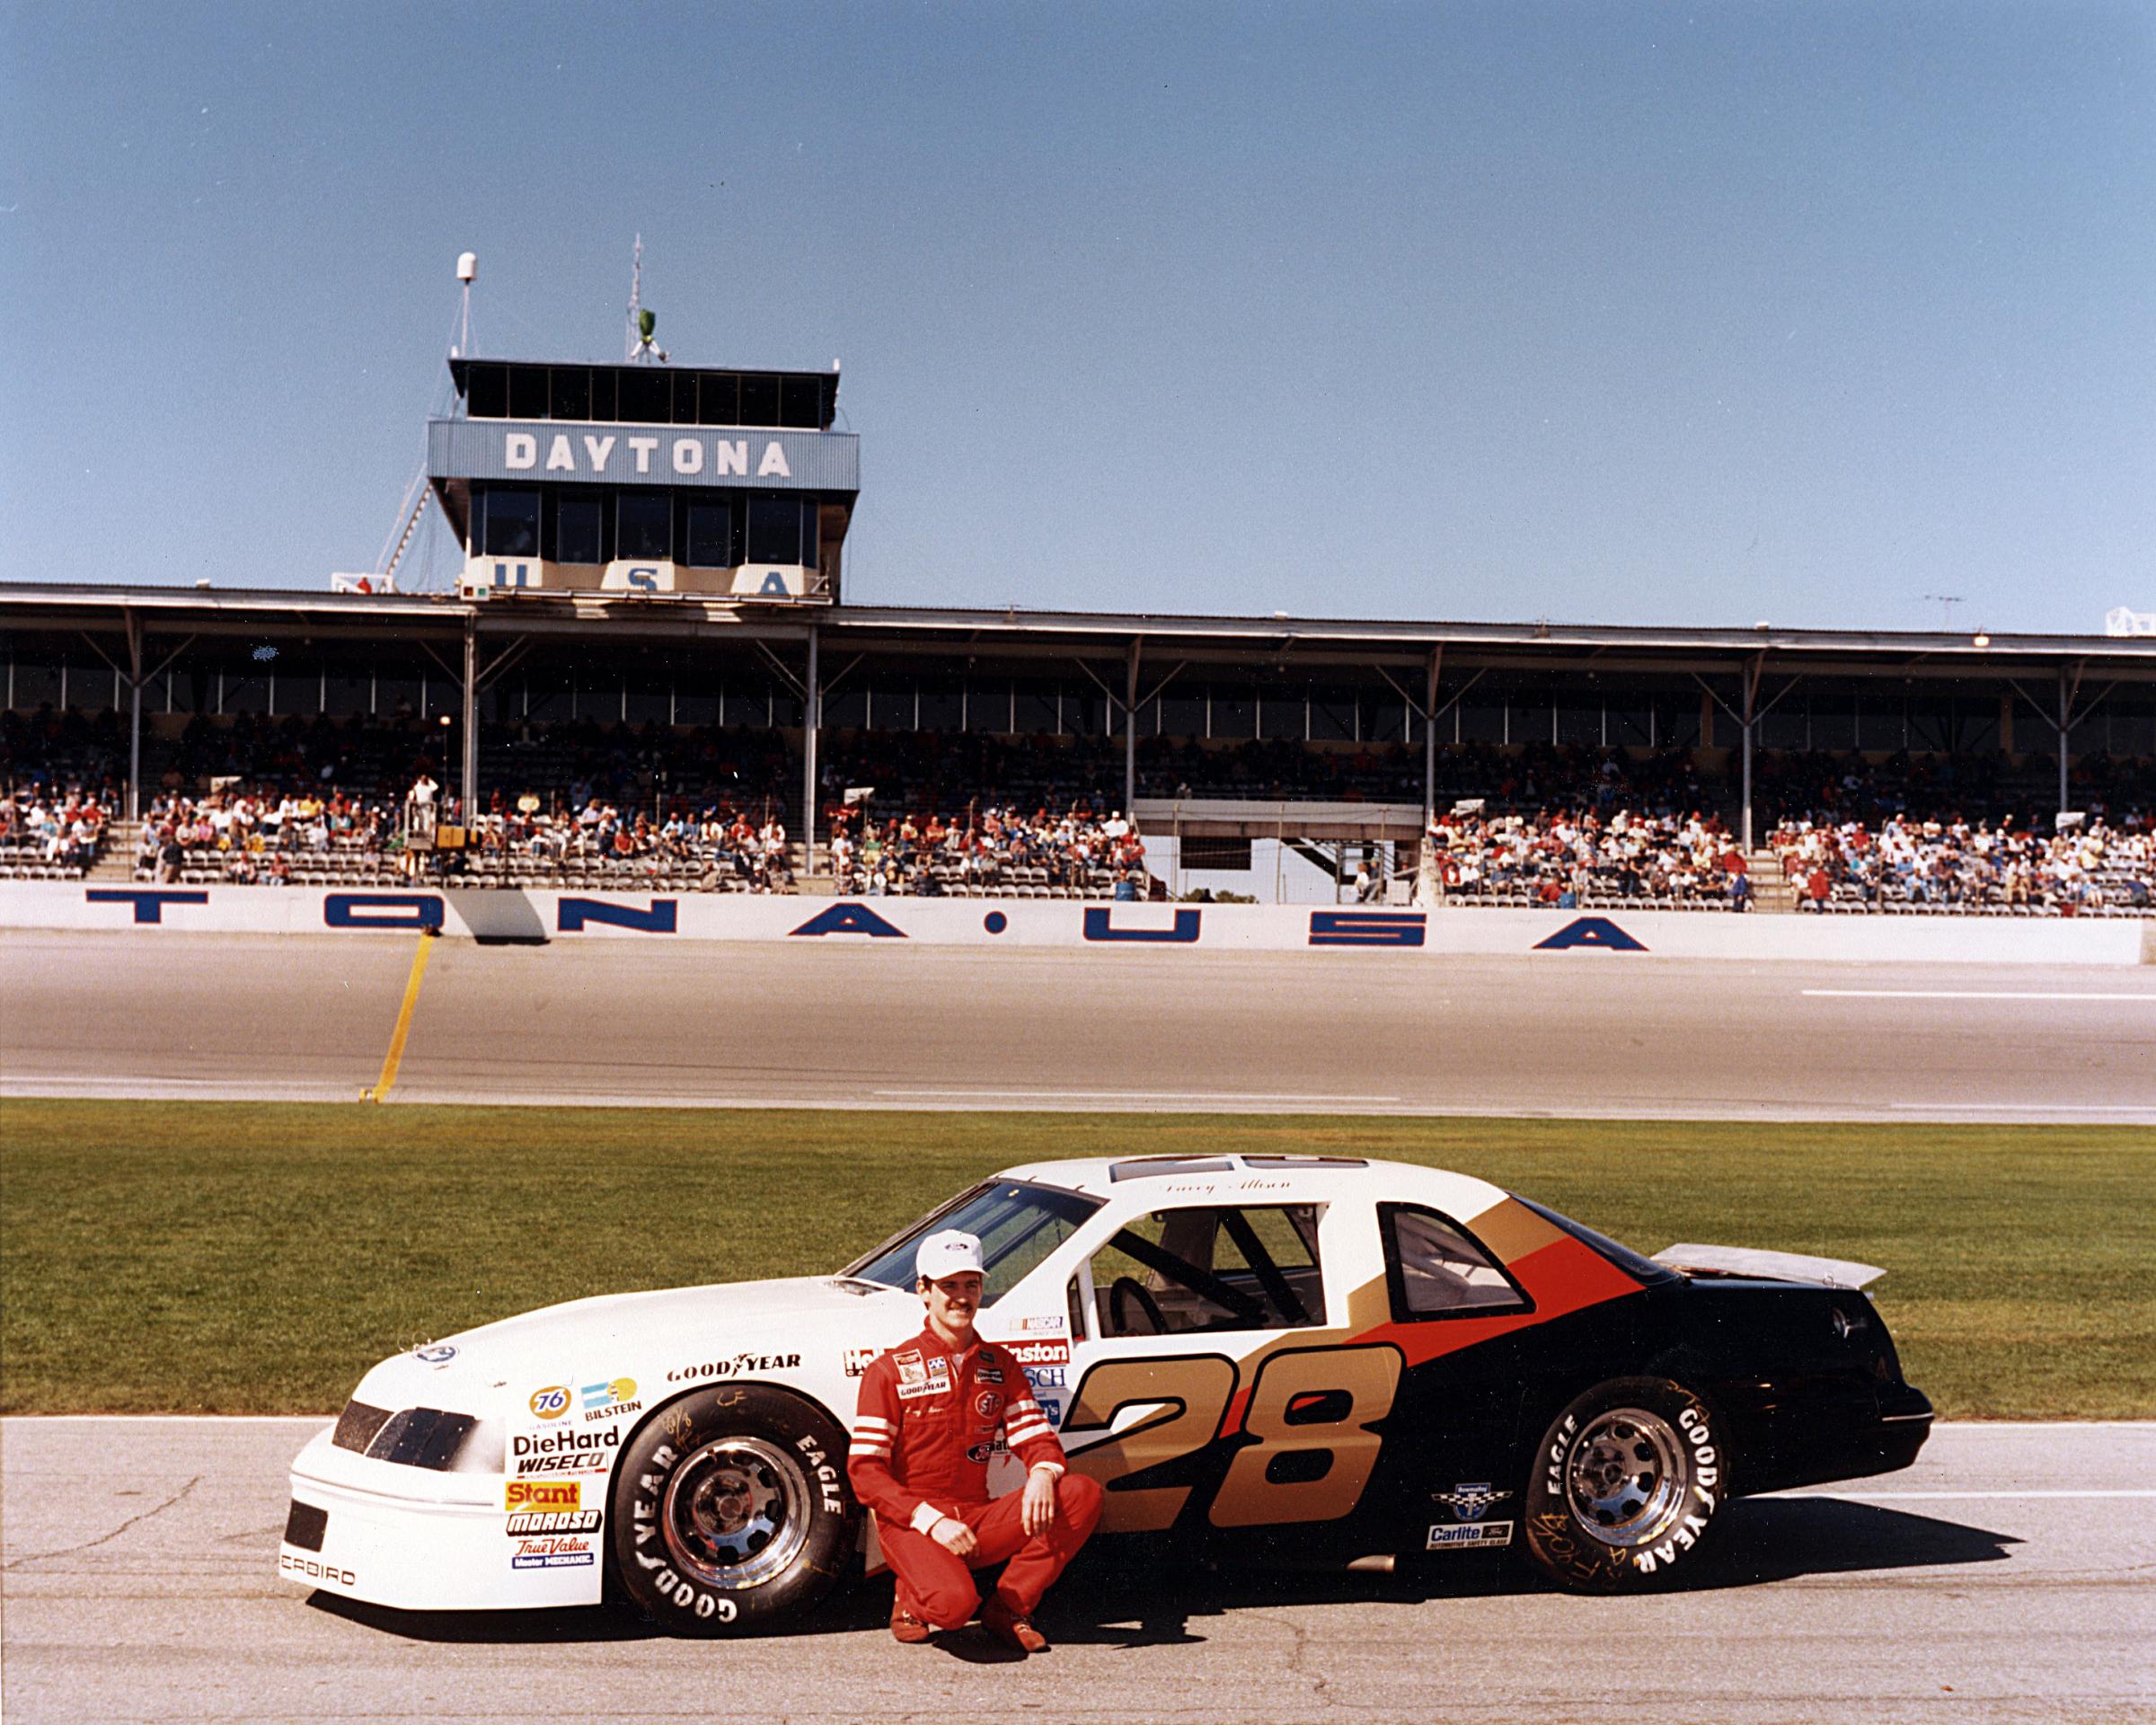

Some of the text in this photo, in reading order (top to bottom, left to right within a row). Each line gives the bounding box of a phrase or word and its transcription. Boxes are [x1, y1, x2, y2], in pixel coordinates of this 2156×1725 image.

[506, 433, 791, 477] DAYTONA
[667, 1353, 801, 1381] GOODYEAR
[1022, 1368, 1066, 1387] SCH
[901, 1382, 946, 1396] GOODYEAR
[538, 1391, 564, 1411] 76
[585, 1401, 642, 1422] BILSTEIN
[513, 1426, 620, 1456] DieHard
[1061, 1341, 1406, 1534] 28
[517, 1453, 605, 1474] WISECO
[1547, 1414, 1578, 1495] EAGLE
[796, 1434, 843, 1515] EAGLE
[508, 1483, 578, 1503] Stant
[506, 1510, 601, 1535] MOROSO
[1431, 1526, 1480, 1542] Carlite
